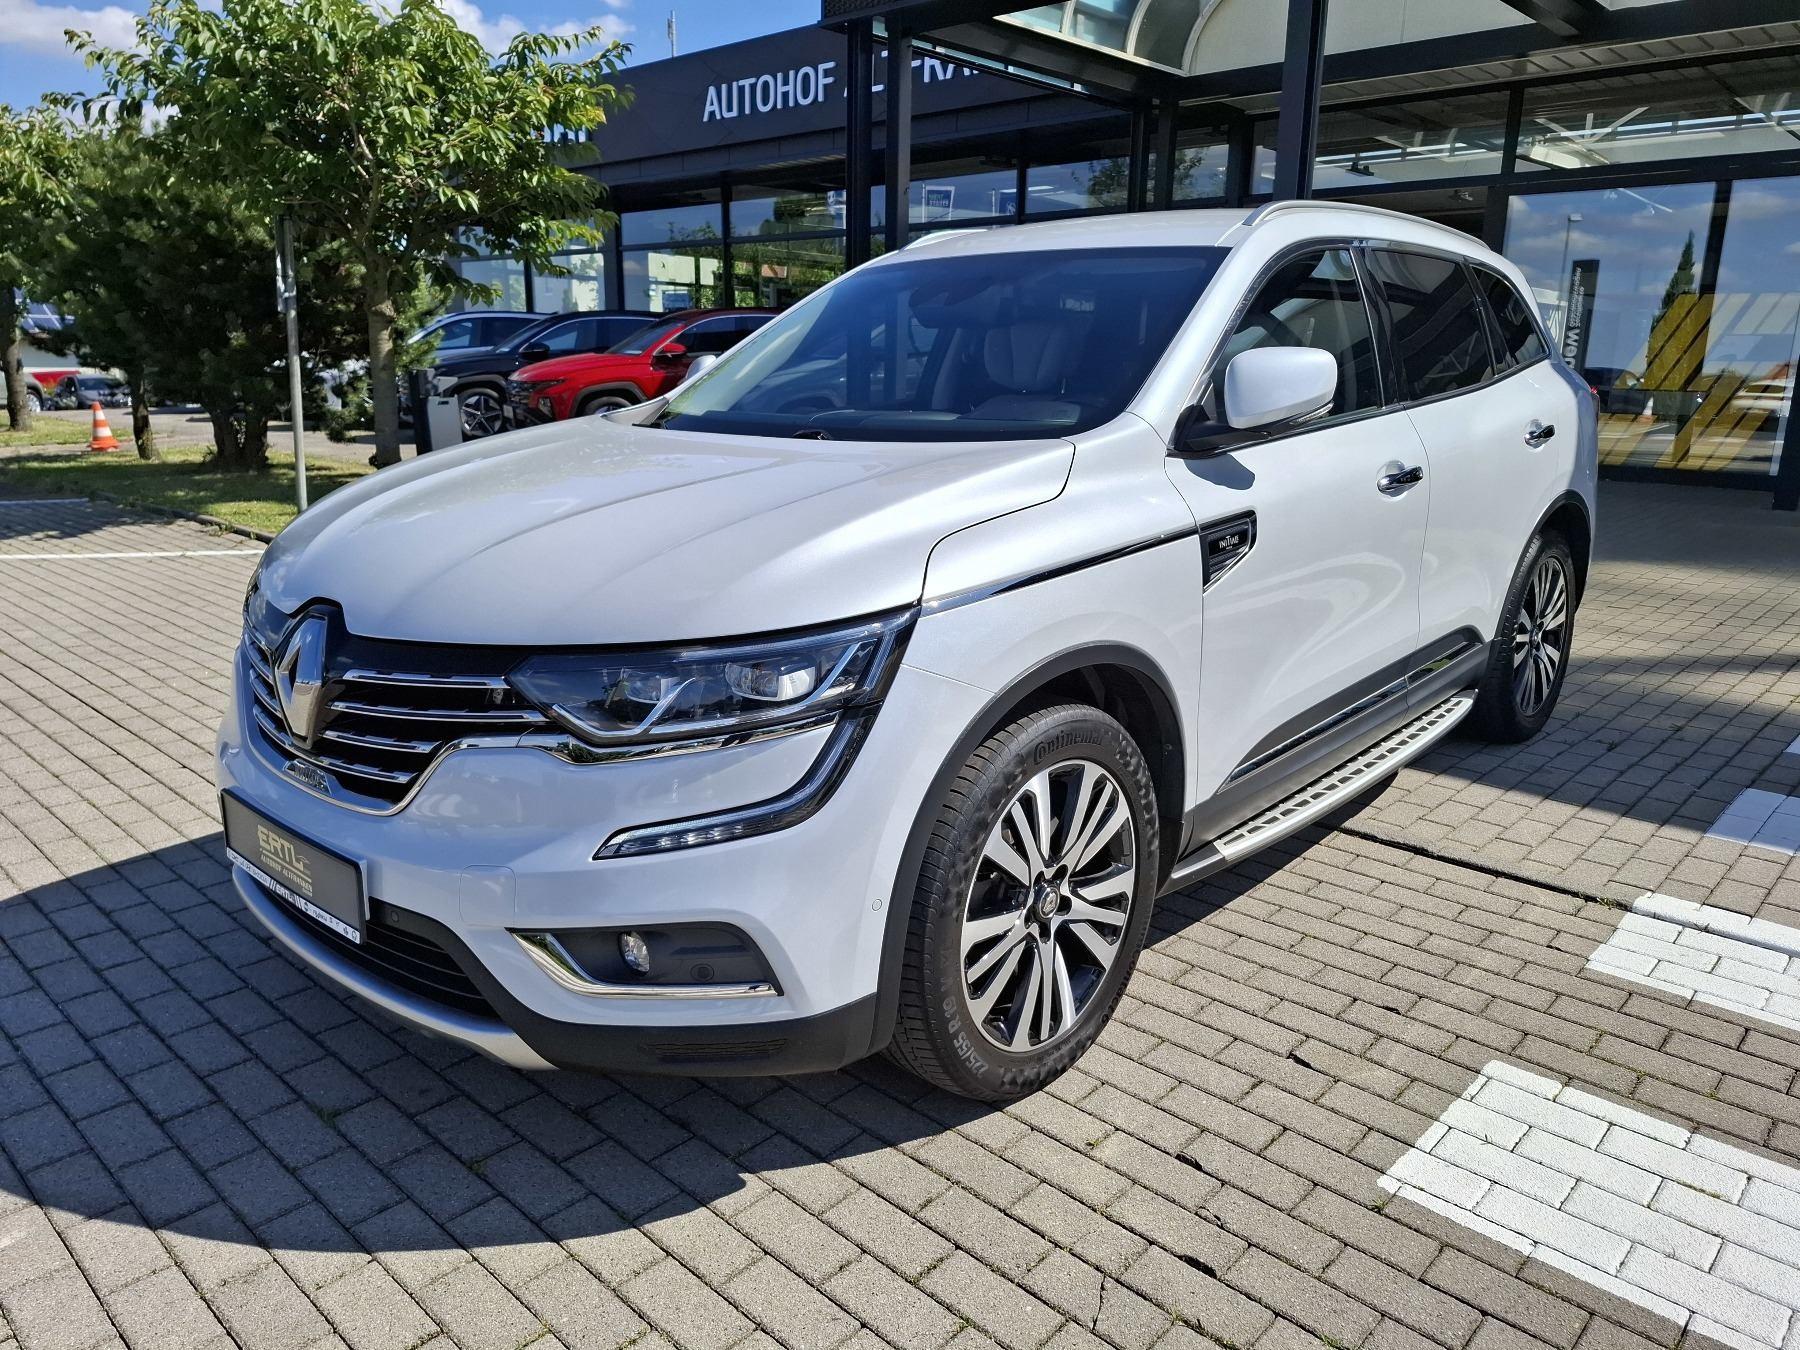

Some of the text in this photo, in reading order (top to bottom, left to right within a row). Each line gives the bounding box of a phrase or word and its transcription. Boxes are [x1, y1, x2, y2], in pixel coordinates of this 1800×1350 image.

[702, 61, 837, 122] AUTOHOF
[1033, 729, 1102, 766] Continental
[257, 824, 304, 871] ERTL
